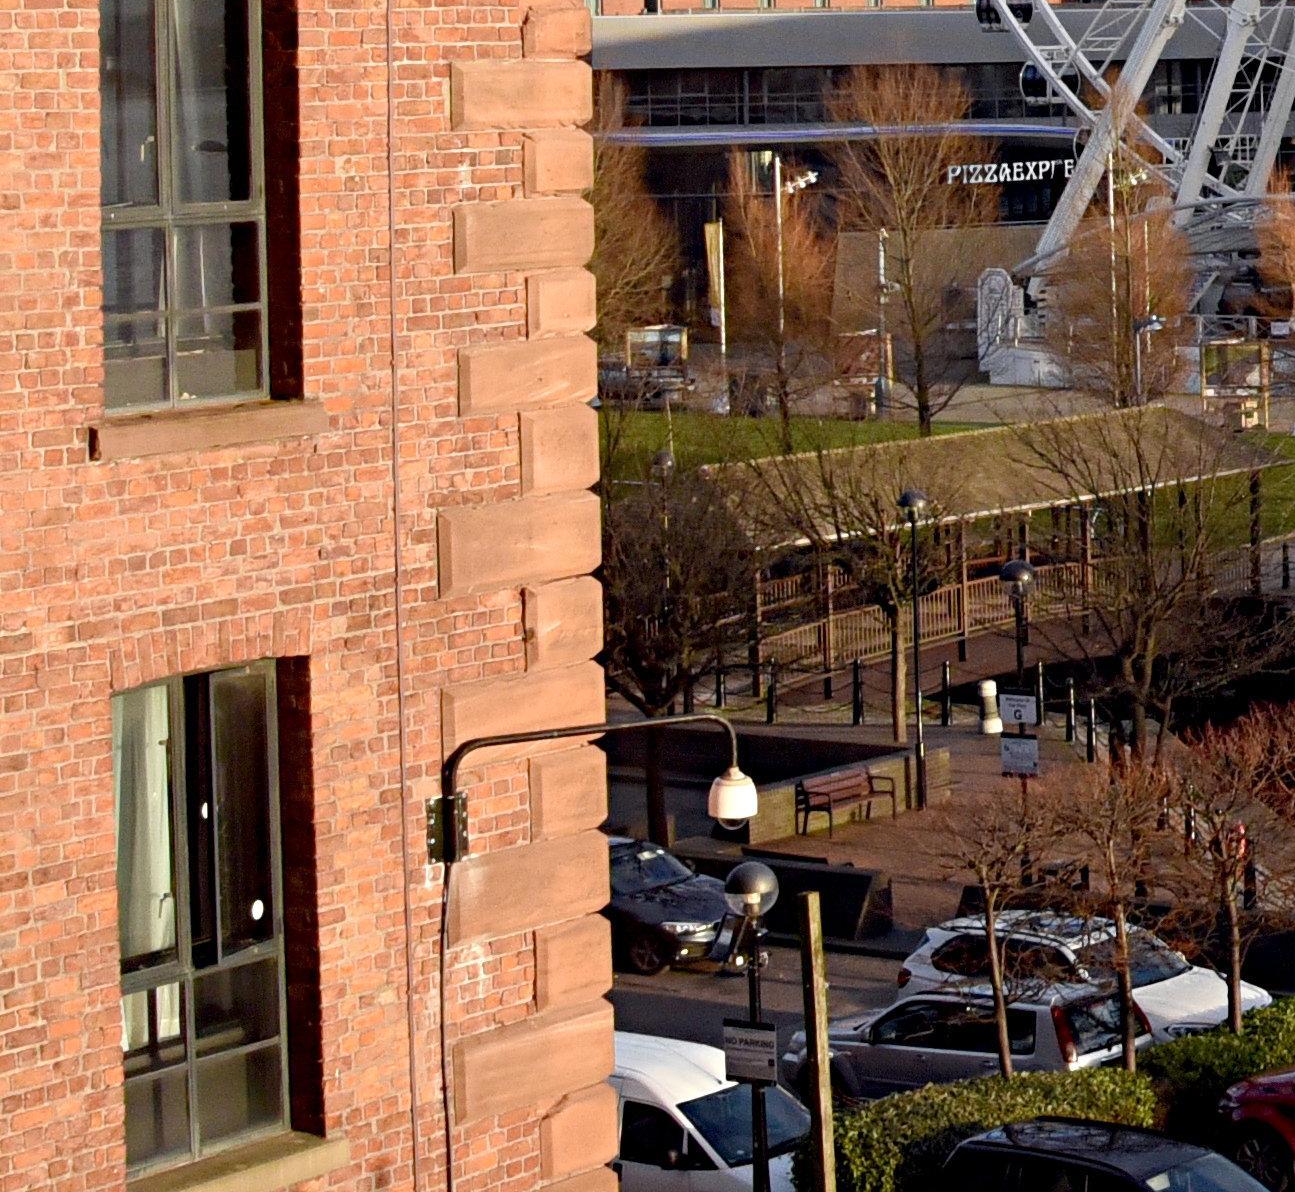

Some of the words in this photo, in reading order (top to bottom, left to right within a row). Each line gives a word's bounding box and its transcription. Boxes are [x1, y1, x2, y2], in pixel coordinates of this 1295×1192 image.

[1013, 708, 1023, 720] G
[725, 1036, 738, 1045] NO
[738, 1037, 774, 1050] PARKING
